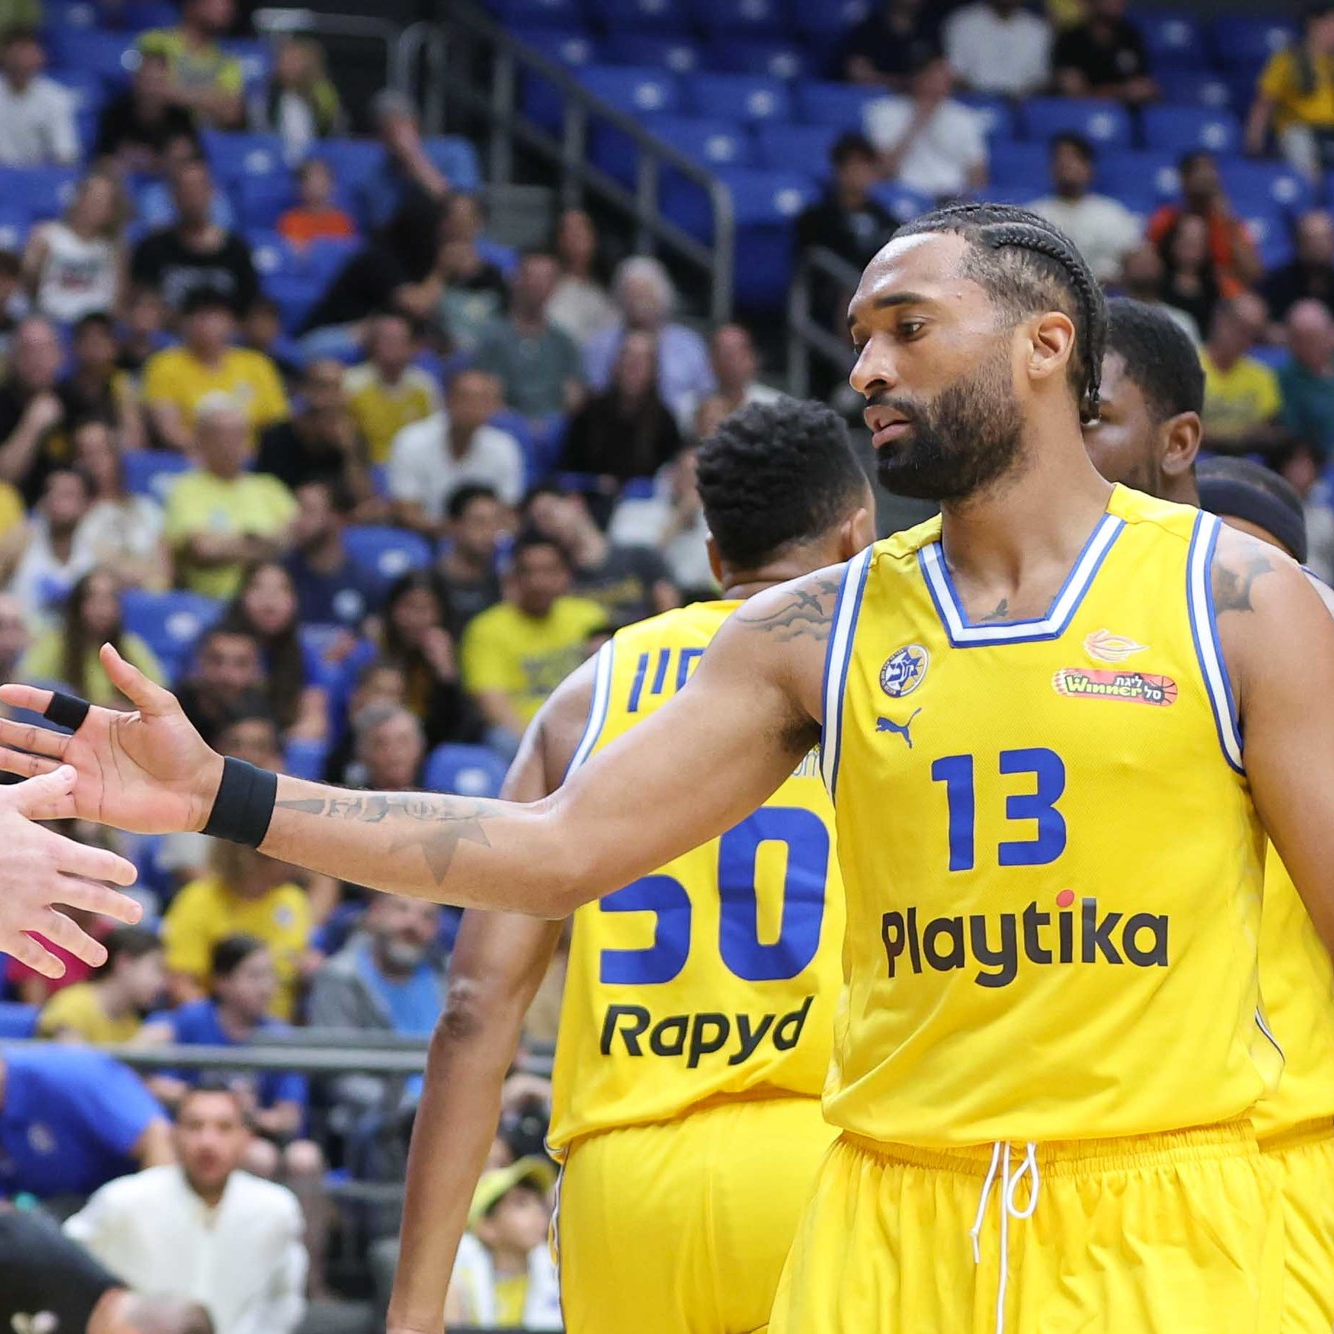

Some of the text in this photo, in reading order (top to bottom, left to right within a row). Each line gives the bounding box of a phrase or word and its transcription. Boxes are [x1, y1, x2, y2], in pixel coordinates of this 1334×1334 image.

[1066, 675, 1142, 697] Winner
[930, 747, 1067, 872] 13
[599, 806, 831, 985] 50
[881, 889, 1169, 988] Playtika
[600, 996, 814, 1069] Rapyd
